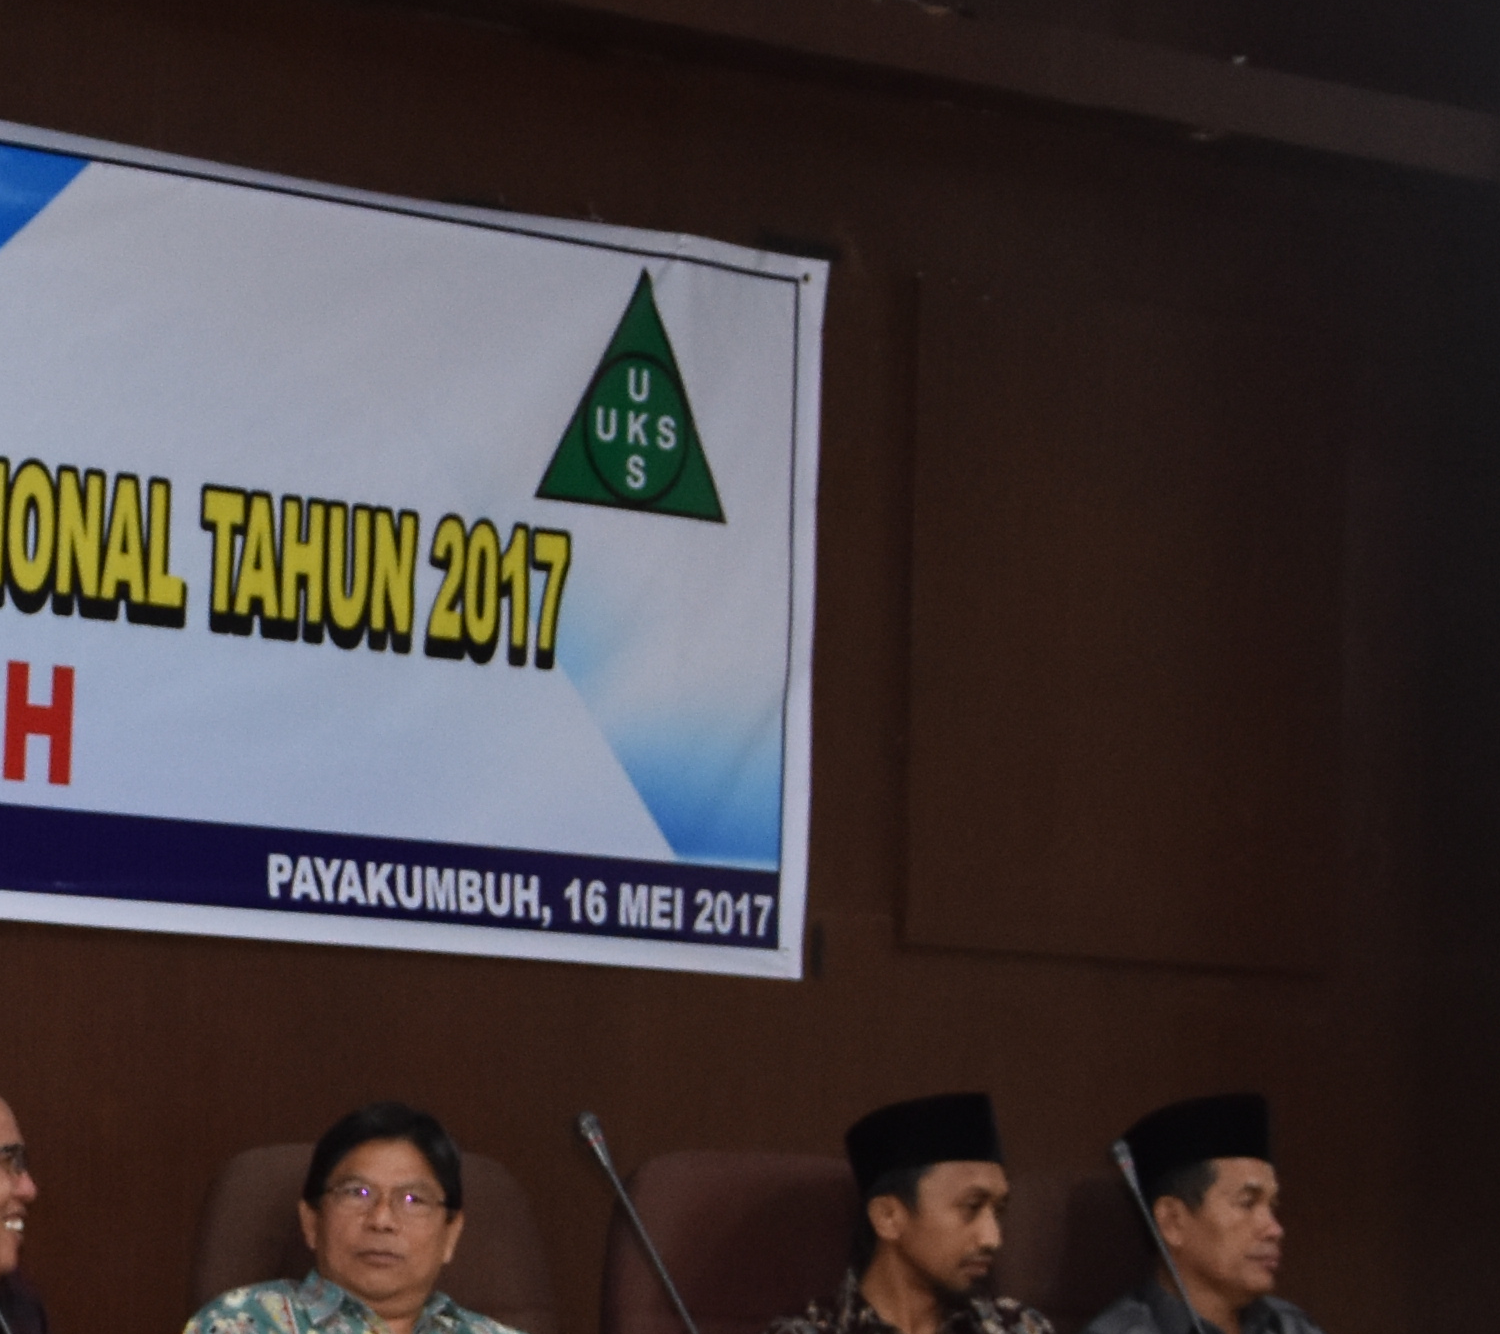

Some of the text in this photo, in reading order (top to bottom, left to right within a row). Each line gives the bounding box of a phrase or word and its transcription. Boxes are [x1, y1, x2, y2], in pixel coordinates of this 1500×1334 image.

[595, 406, 677, 451] UKS
[199, 484, 420, 644] TAHUN
[423, 513, 573, 661] 2017
[266, 852, 774, 938] PAYAKUMBUH, 16 MEI 2017
